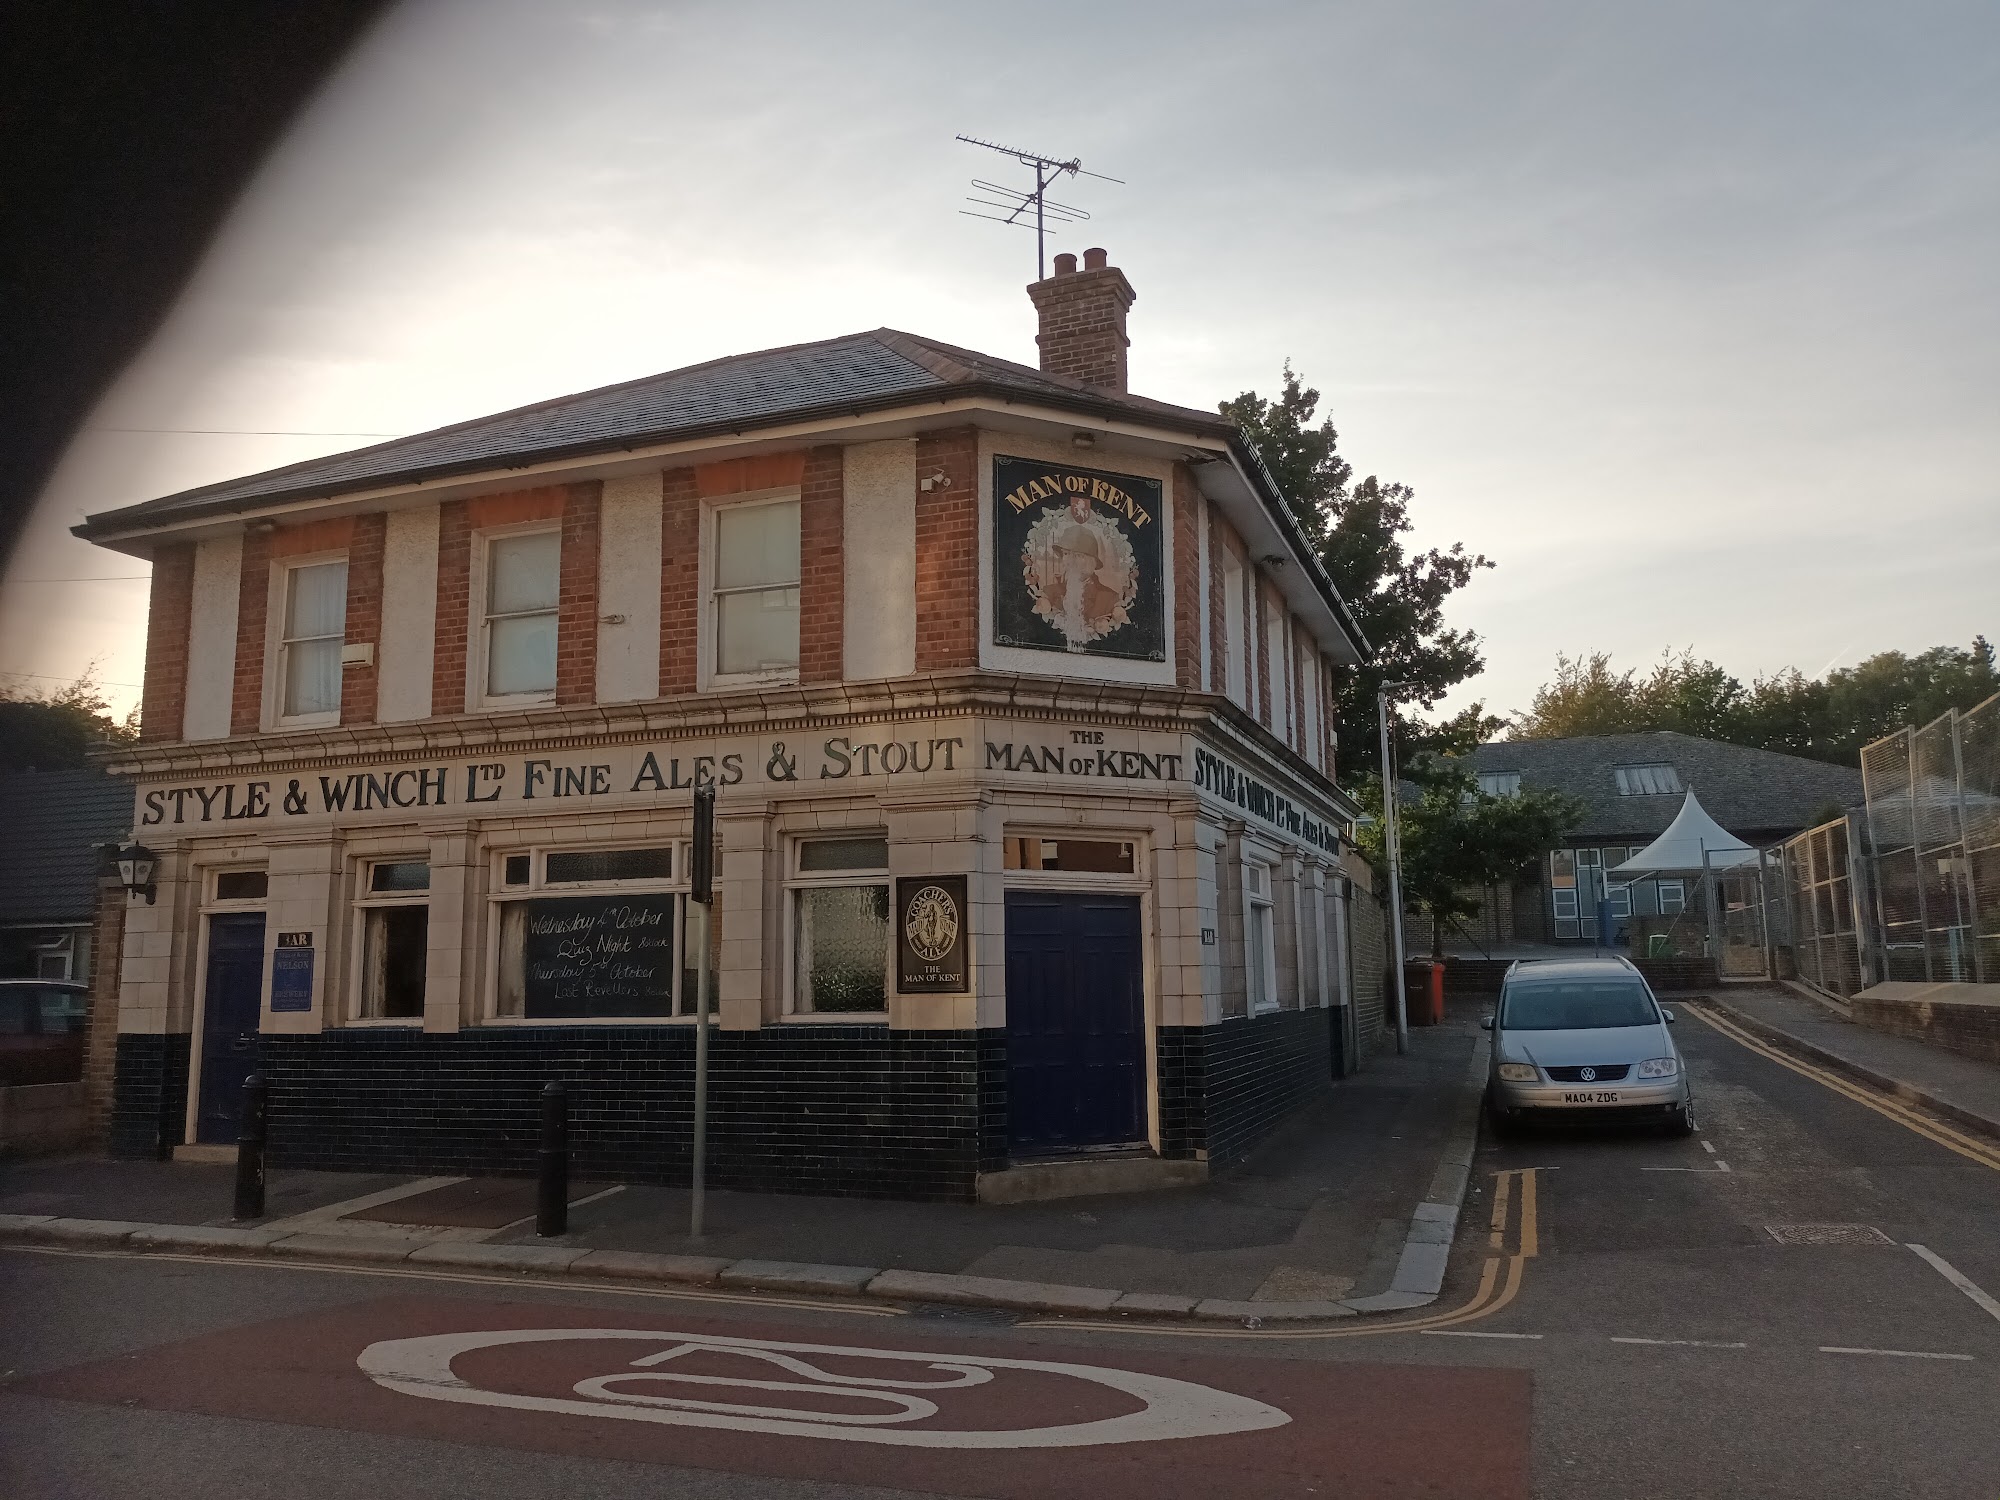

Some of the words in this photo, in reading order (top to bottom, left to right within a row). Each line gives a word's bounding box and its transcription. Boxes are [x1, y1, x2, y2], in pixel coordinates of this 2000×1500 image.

[1005, 474, 1063, 515] MAN
[1065, 475, 1089, 493] OF
[1091, 478, 1152, 530] KENT
[1069, 730, 1105, 744] THE
[985, 742, 1065, 774] MAN
[1069, 758, 1095, 775] OF
[1097, 750, 1182, 780] KENT
[142, 781, 271, 825] STYLE
[283, 779, 308, 815] &
[319, 767, 449, 812] WINCH
[522, 759, 611, 799] FINE
[630, 751, 743, 791] ALES
[766, 741, 798, 781] &
[820, 737, 963, 779] STOUT
[1195, 747, 1236, 803] STYLE
[1237, 772, 1247, 808] &
[1245, 776, 1275, 823] WINCH
[530, 912, 595, 945] Wednesday
[615, 905, 663, 929] October
[556, 937, 593, 966] Quiz
[596, 934, 632, 964] Night
[920, 946, 943, 958] ALE
[610, 963, 657, 980] October
[905, 974, 924, 982] MAN
[926, 974, 937, 982] OF
[939, 973, 961, 982] KENT
[924, 965, 941, 973] THE
[1565, 1093, 1594, 1103] MA04
[1596, 1092, 1618, 1103] ZDG
